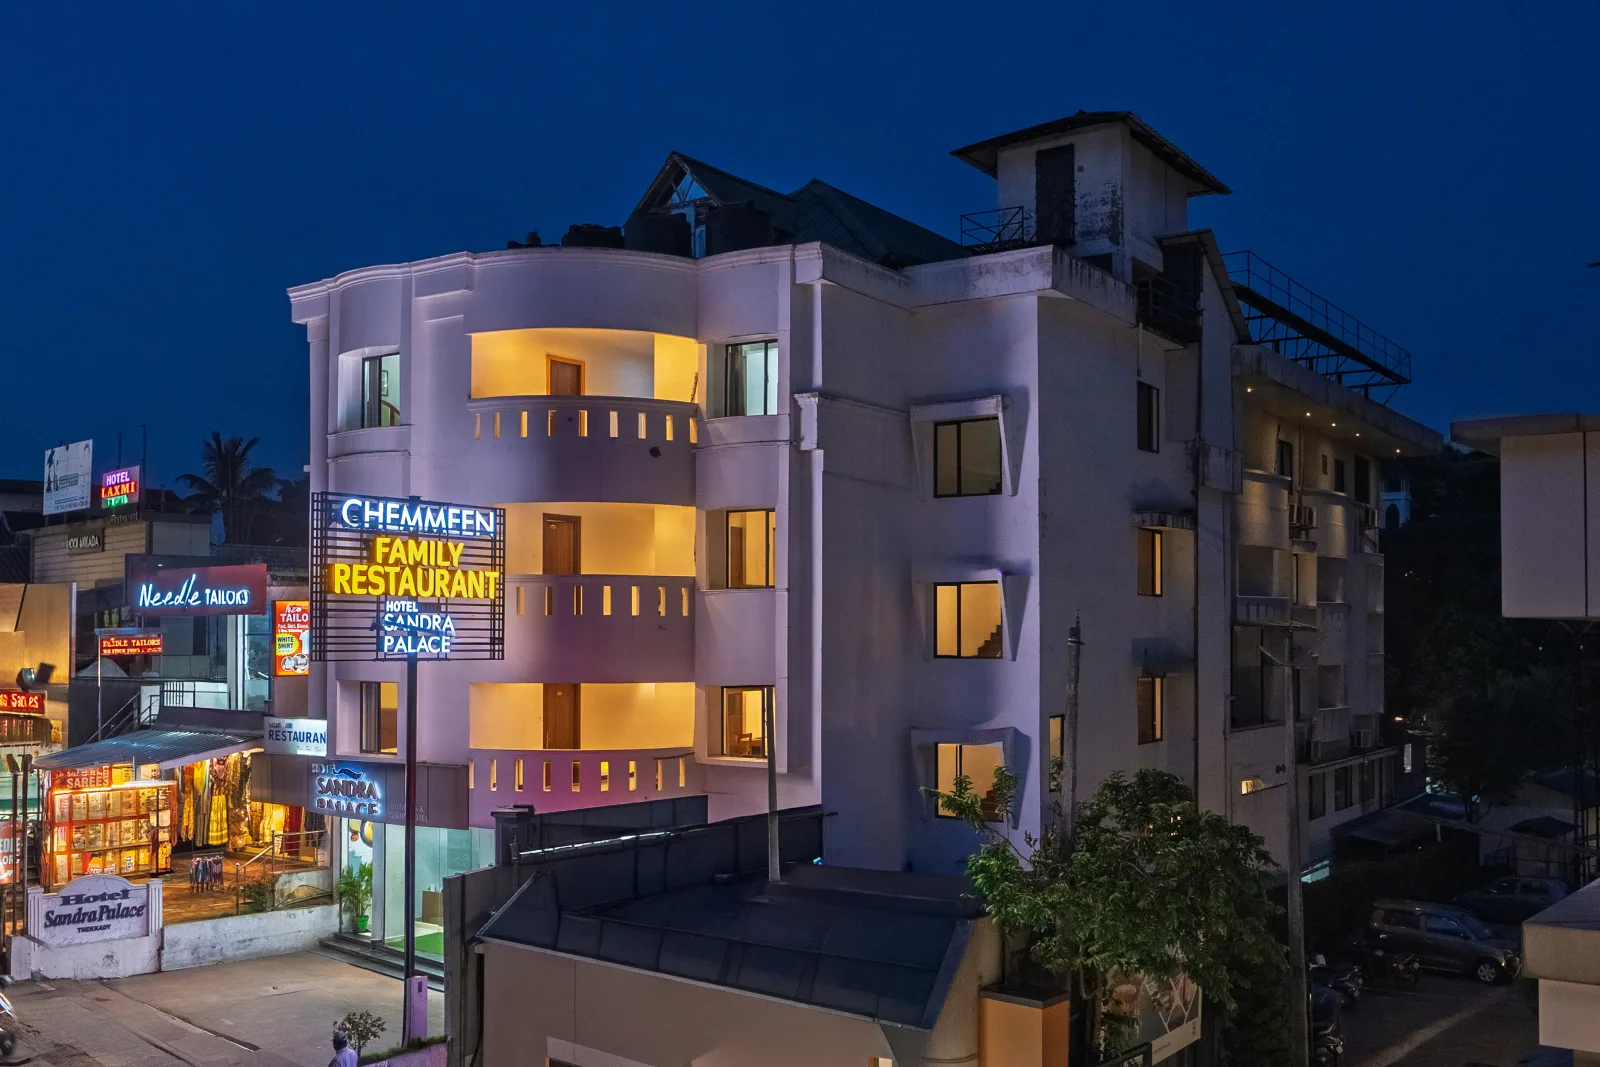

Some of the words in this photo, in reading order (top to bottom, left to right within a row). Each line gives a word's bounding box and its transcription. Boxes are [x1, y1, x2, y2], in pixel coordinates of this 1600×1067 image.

[106, 471, 130, 486] HOTEL
[101, 482, 136, 499] LAXMI
[341, 498, 495, 538] CHEMMEEN
[375, 537, 465, 568] FAMILY
[139, 573, 202, 609] Needle
[333, 563, 501, 600] RESTAURANT
[386, 601, 419, 613] HOTEL
[383, 614, 456, 635] SANDRA
[383, 635, 452, 654] PALACE
[316, 776, 379, 800] SANDRA
[60, 889, 131, 906] Hotel
[43, 907, 97, 929] Sandra
[97, 903, 146, 922] Palace
[77, 923, 112, 934] THEKKADY
